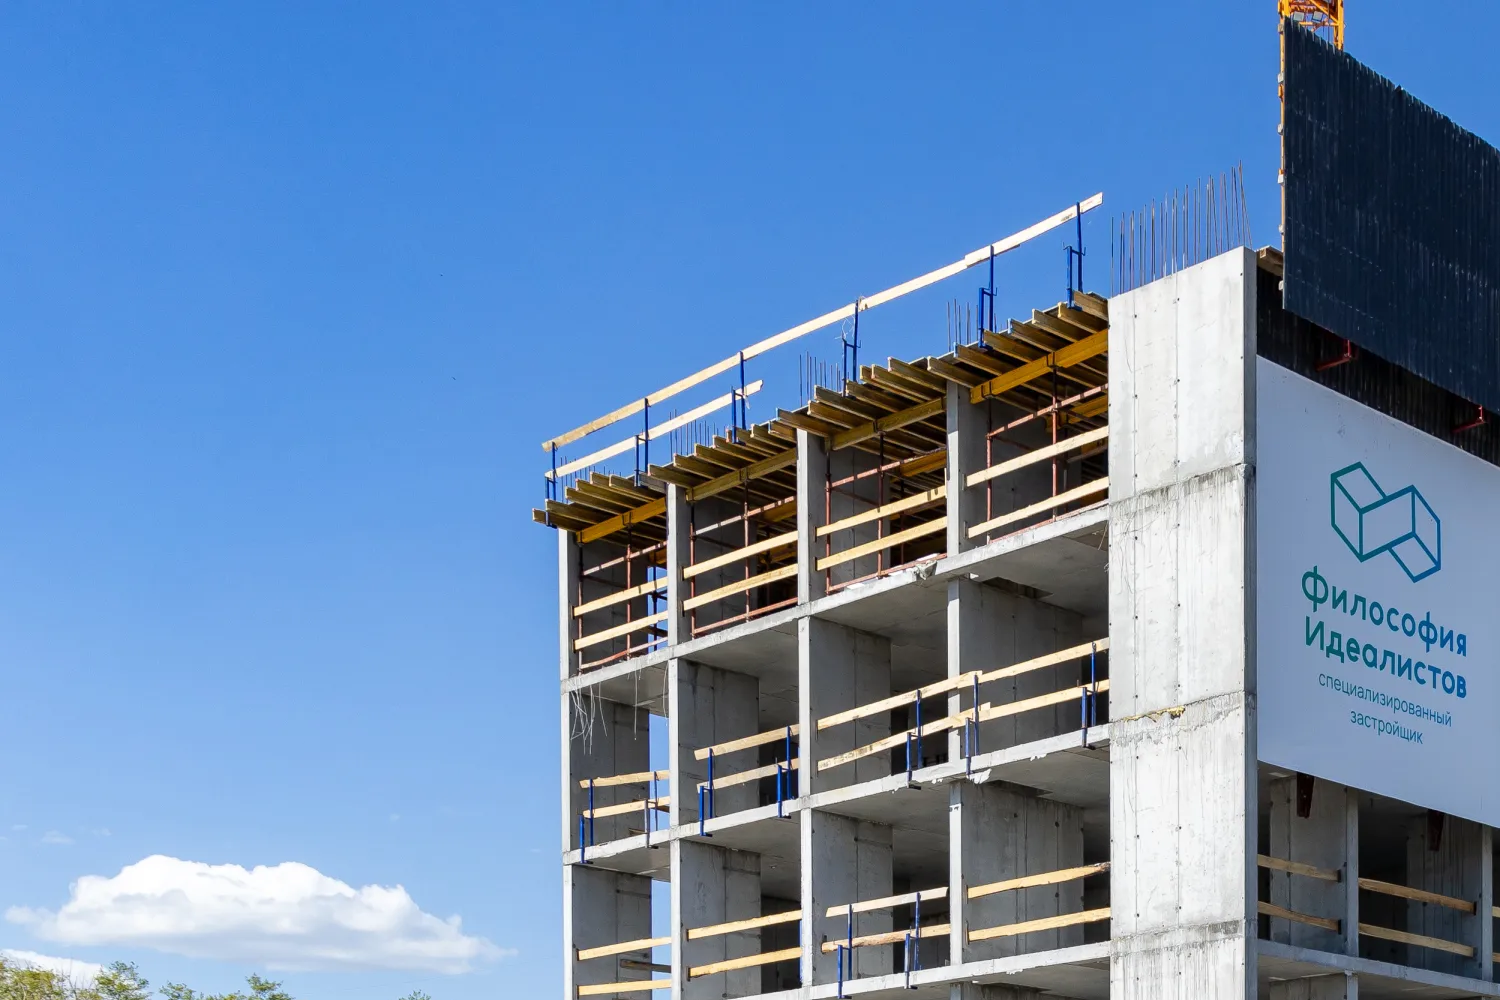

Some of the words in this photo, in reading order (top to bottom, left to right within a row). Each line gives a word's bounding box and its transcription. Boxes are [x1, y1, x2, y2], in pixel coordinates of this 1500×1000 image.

[1301, 565, 1467, 657] Философия
[1305, 615, 1467, 699] Идеалистов
[1318, 673, 1452, 727] специализированный
[1350, 710, 1423, 744] застройщик
